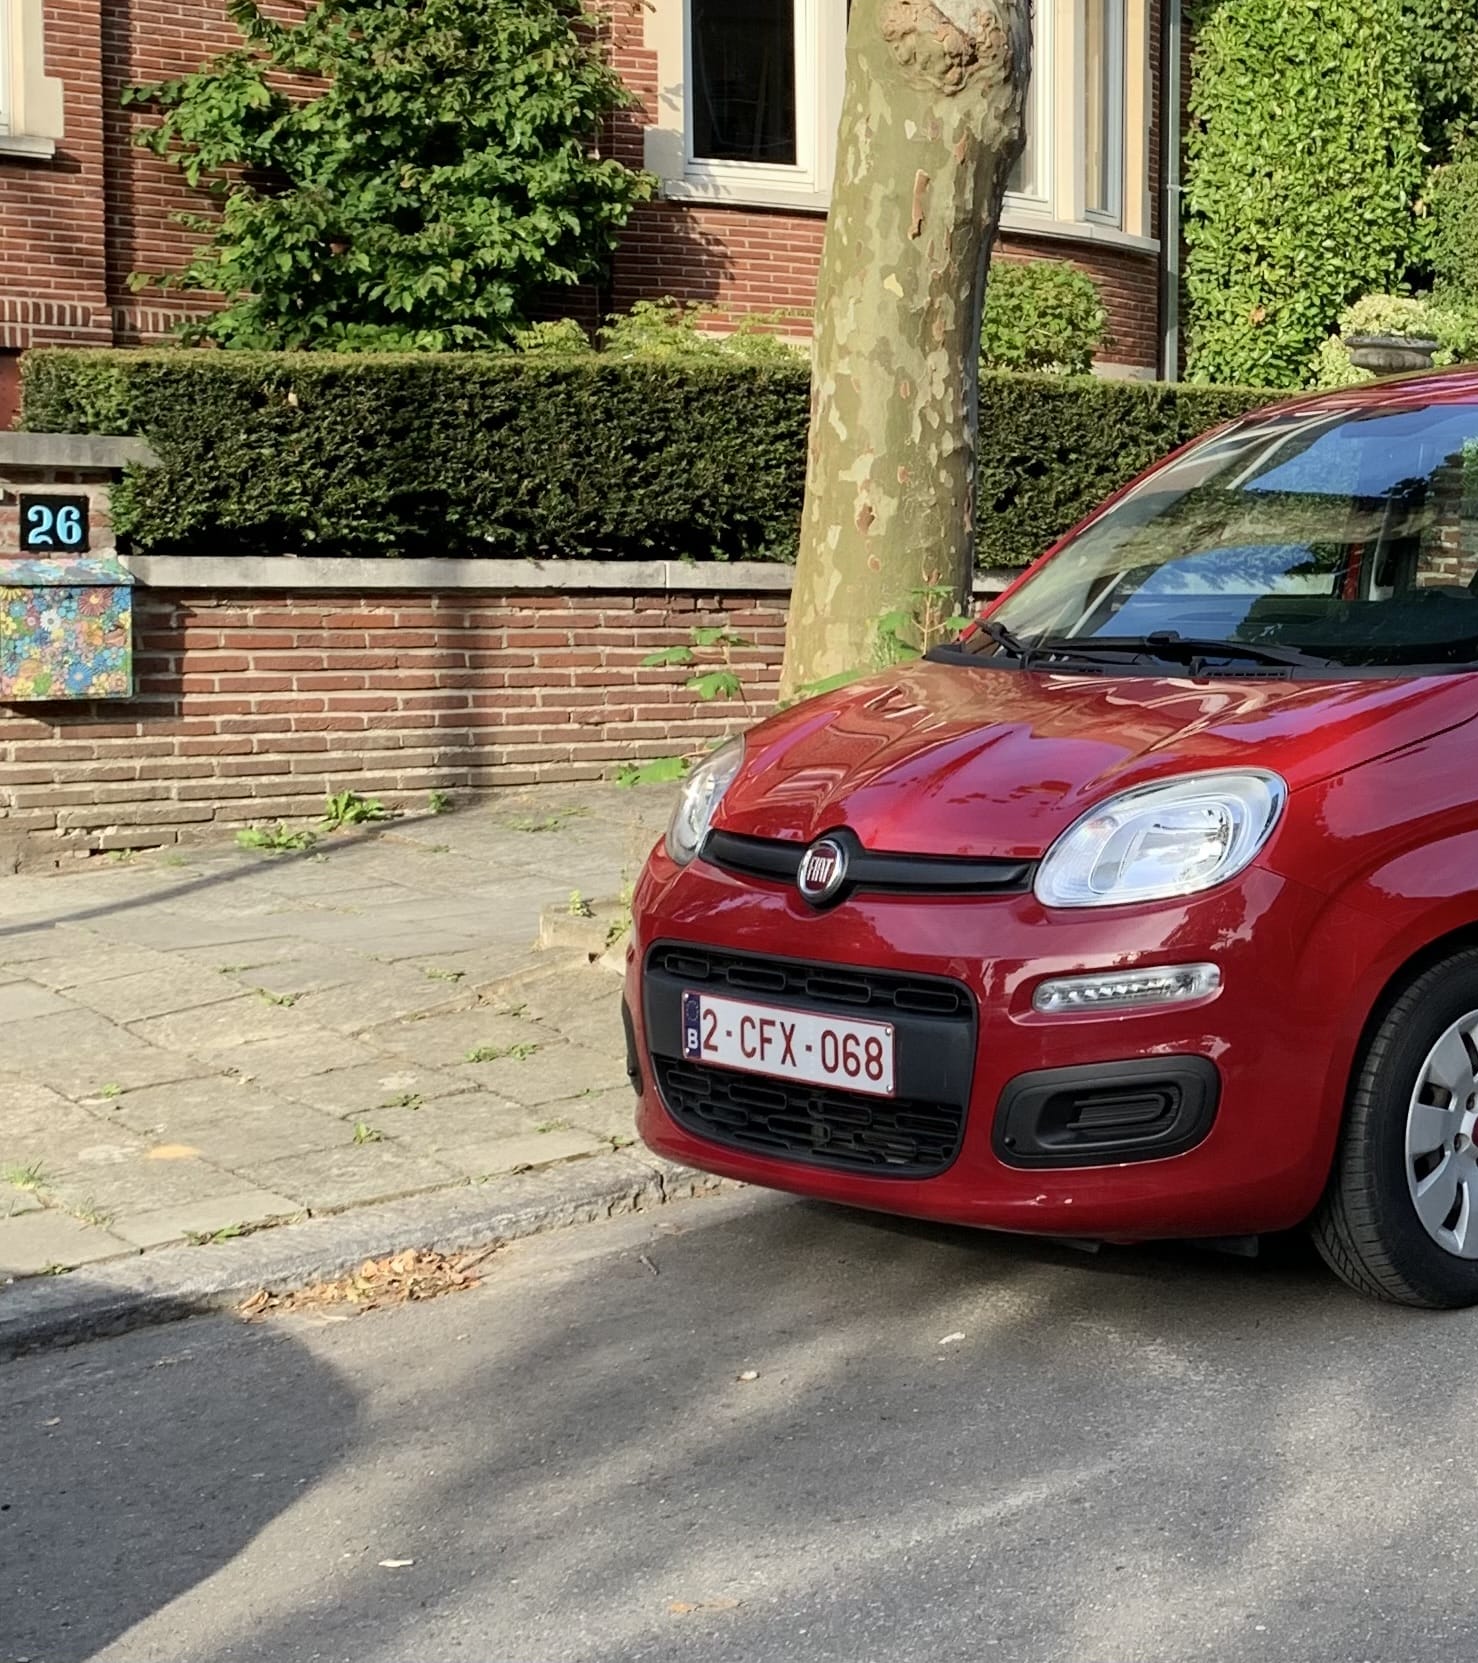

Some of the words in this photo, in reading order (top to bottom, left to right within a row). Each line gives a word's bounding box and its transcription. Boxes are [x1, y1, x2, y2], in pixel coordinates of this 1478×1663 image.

[27, 505, 82, 544] 26
[806, 856, 834, 883] FIAT
[687, 1028, 698, 1049] B
[702, 1008, 884, 1081] 2-CFX-068
